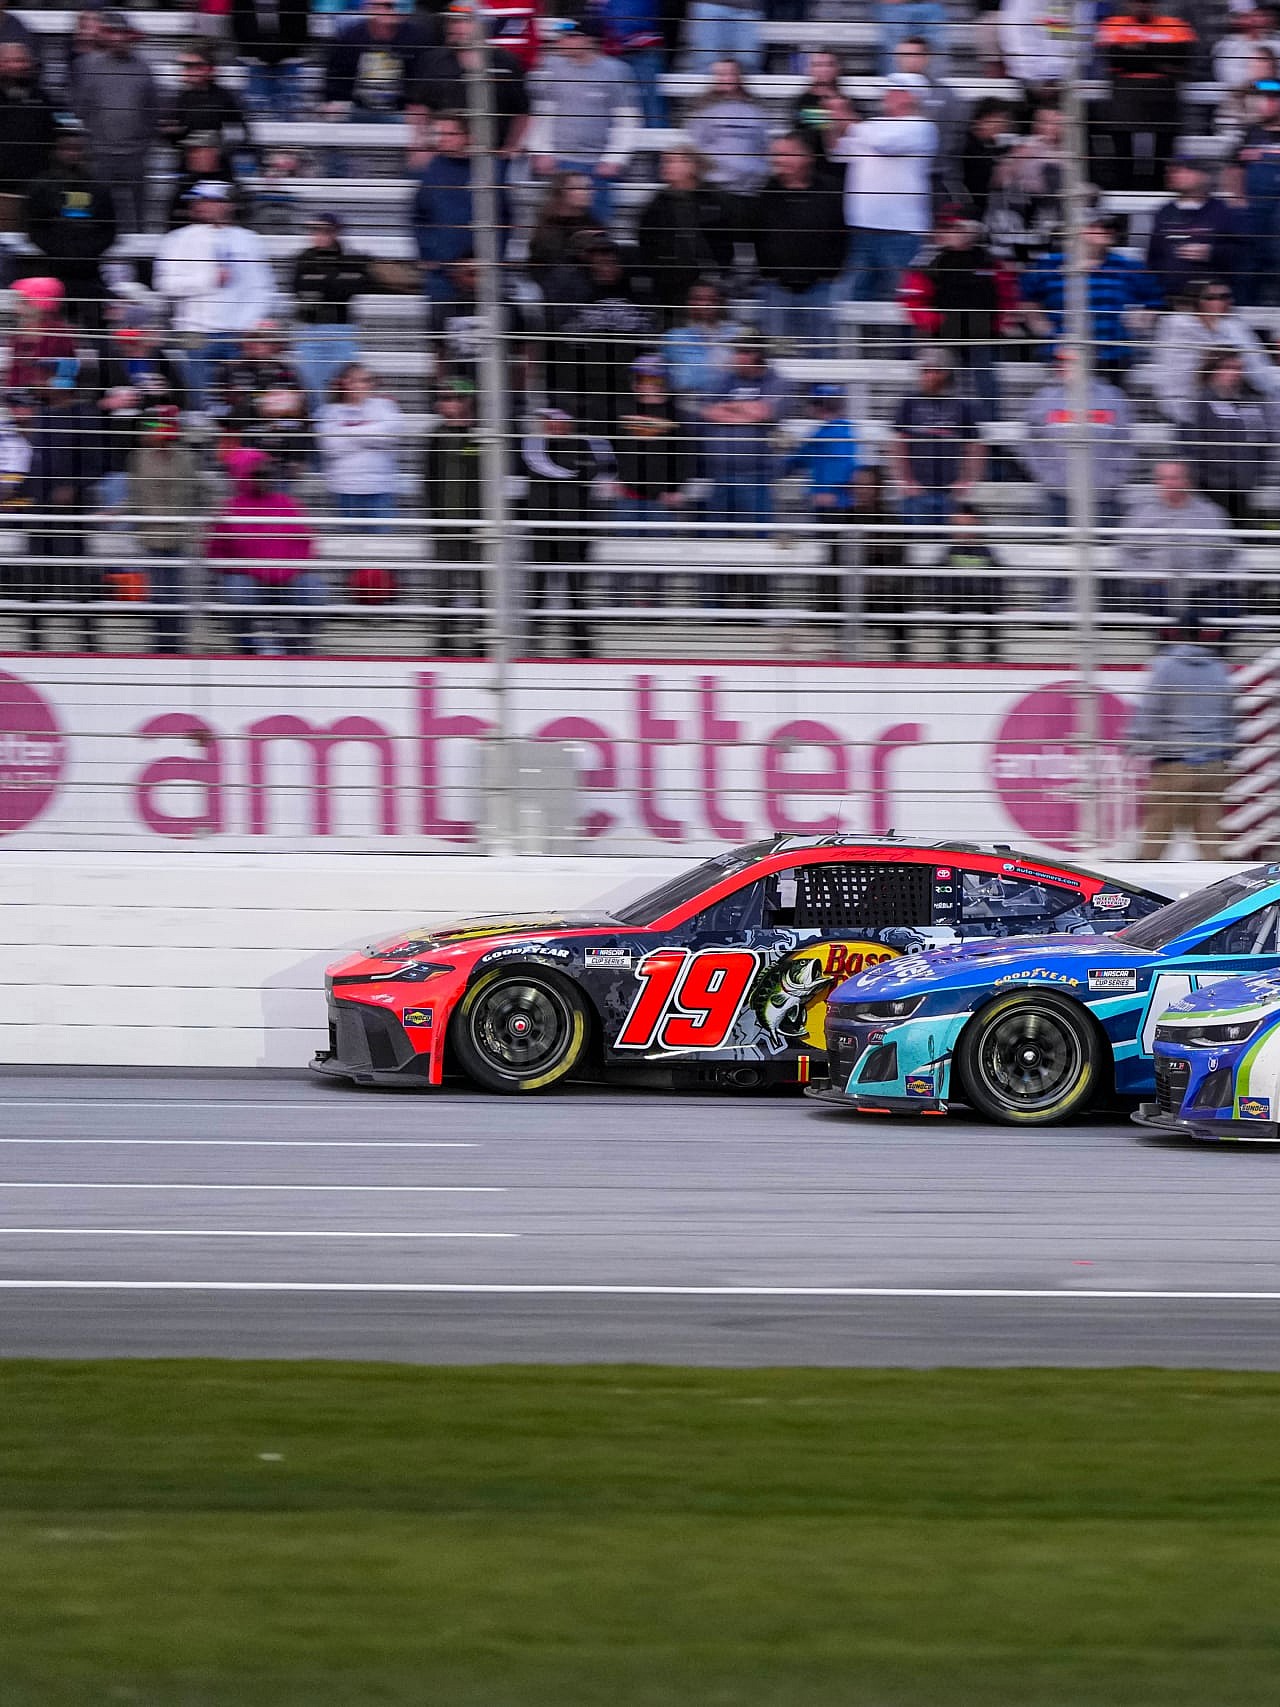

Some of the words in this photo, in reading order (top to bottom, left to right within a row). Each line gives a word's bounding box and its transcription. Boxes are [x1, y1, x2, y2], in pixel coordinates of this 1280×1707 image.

[1016, 867, 1079, 886] auto-owners.com
[481, 945, 570, 963] GOODYEAR
[605, 957, 625, 965] SERIES
[994, 968, 1079, 987] GOODYEAR
[1095, 978, 1109, 986] CUP
[615, 948, 759, 1050] 19
[1240, 1103, 1269, 1112] SUNOCO
